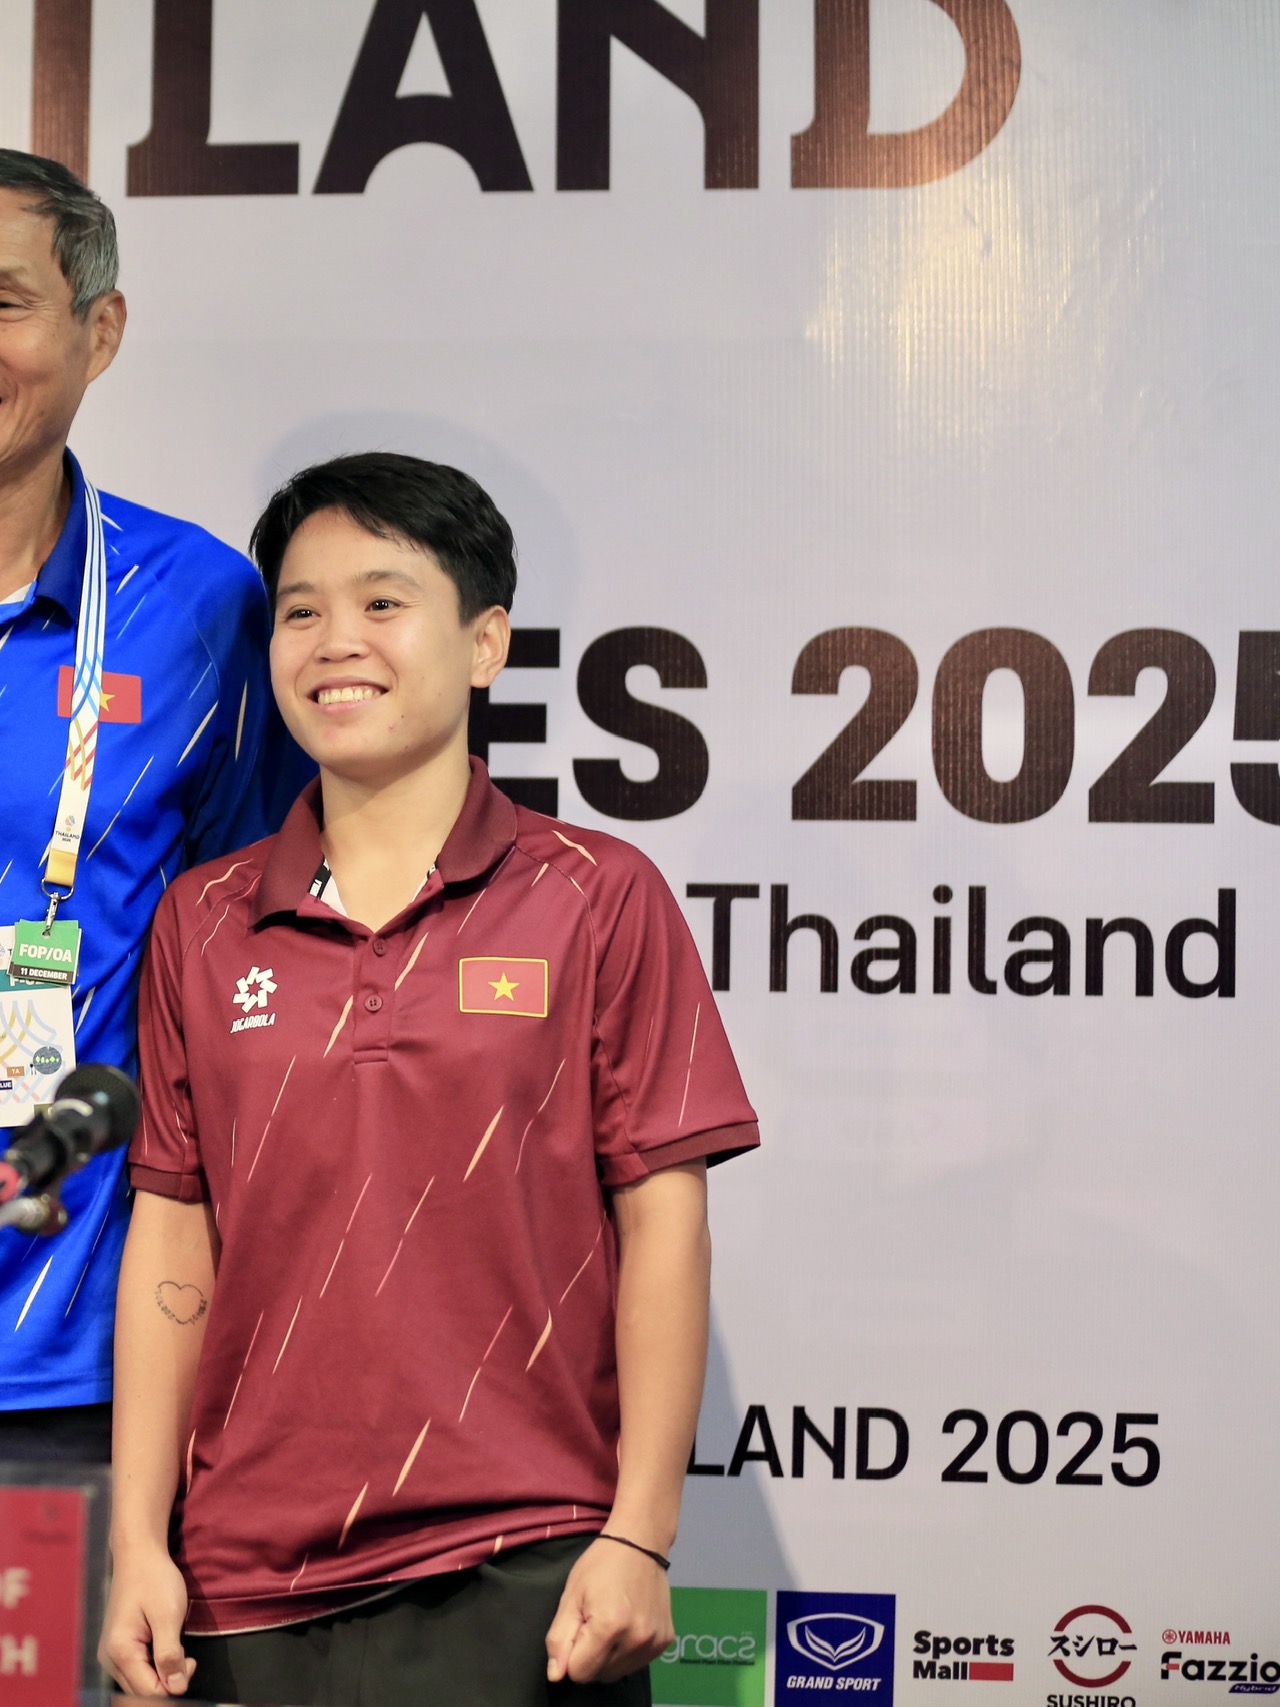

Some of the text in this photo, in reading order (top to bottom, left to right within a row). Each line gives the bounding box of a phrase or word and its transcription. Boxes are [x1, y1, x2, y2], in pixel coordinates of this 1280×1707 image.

[685, 884, 1237, 999] Thailand
[19, 943, 73, 963] FOP/OA
[21, 967, 68, 980] 11 DECEMBER
[941, 1408, 1161, 1488] 2025
[913, 1630, 1015, 1660] Sports
[1047, 1635, 1138, 1658] スシロー
[1178, 1630, 1231, 1645] YAMAHA
[913, 1660, 968, 1681] Mall
[1160, 1651, 1280, 1683] Fazzio
[786, 1675, 882, 1691] GRAND SPORT
[1234, 1684, 1277, 1693] Hybrid
